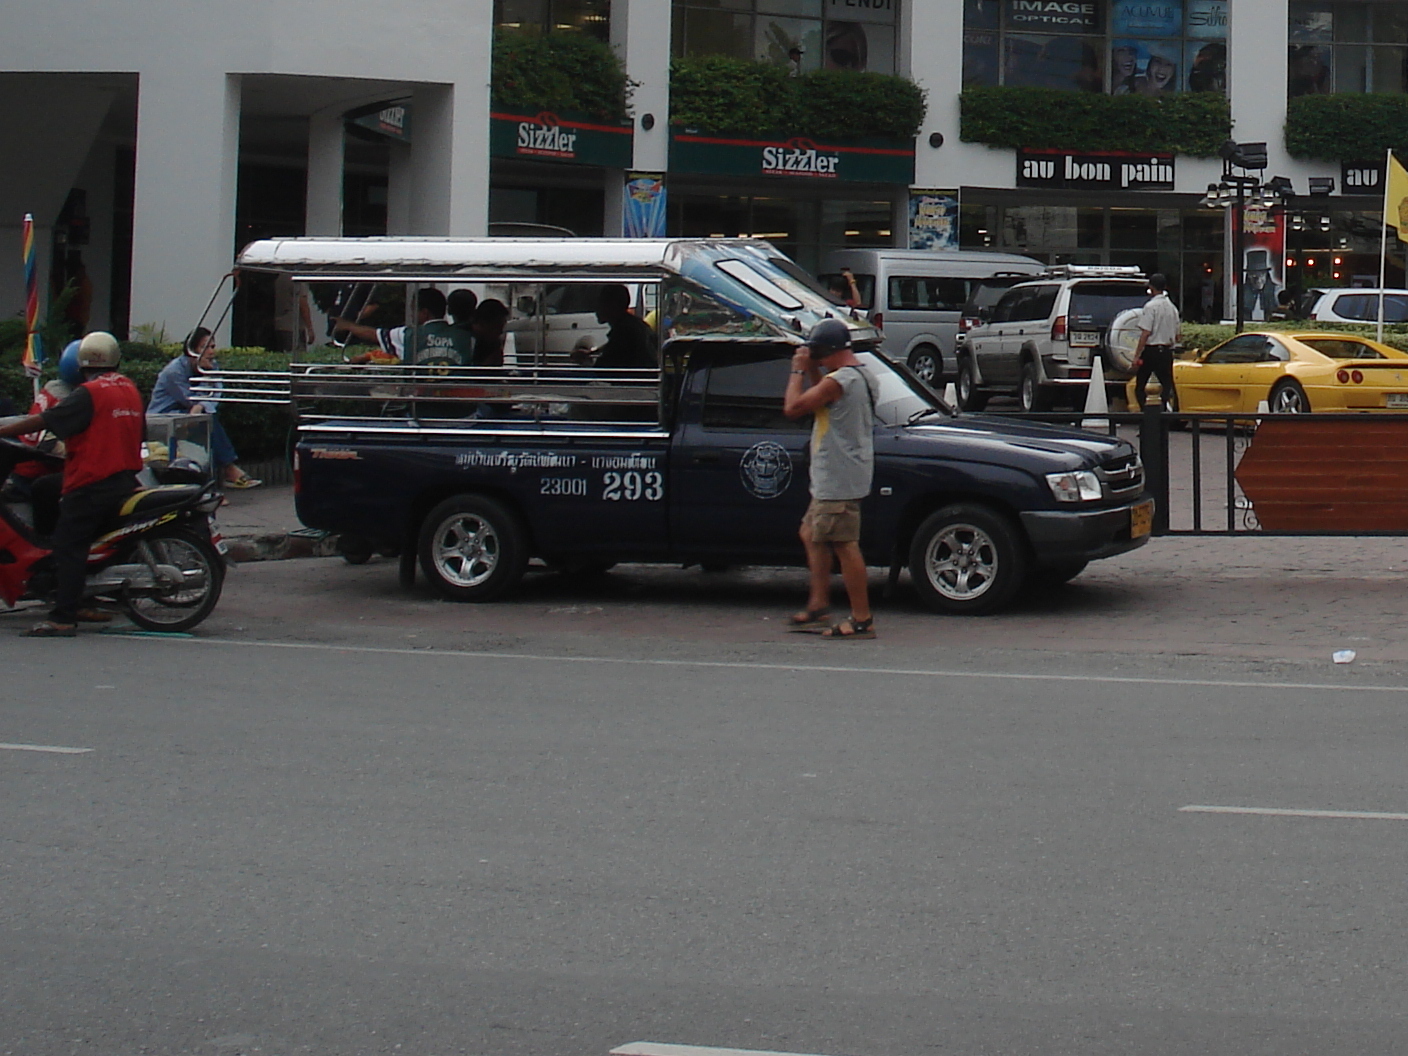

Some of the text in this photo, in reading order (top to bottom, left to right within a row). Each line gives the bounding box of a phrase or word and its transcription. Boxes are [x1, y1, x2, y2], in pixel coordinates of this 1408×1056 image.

[1012, 0, 1095, 14] IMAGE
[1012, 14, 1095, 25] OPTICAL
[517, 122, 576, 152] Sizzler
[762, 146, 839, 173] Sizzler
[1022, 155, 1173, 188] au bon pain
[1346, 168, 1379, 186] au
[540, 471, 664, 501] 23001 293
